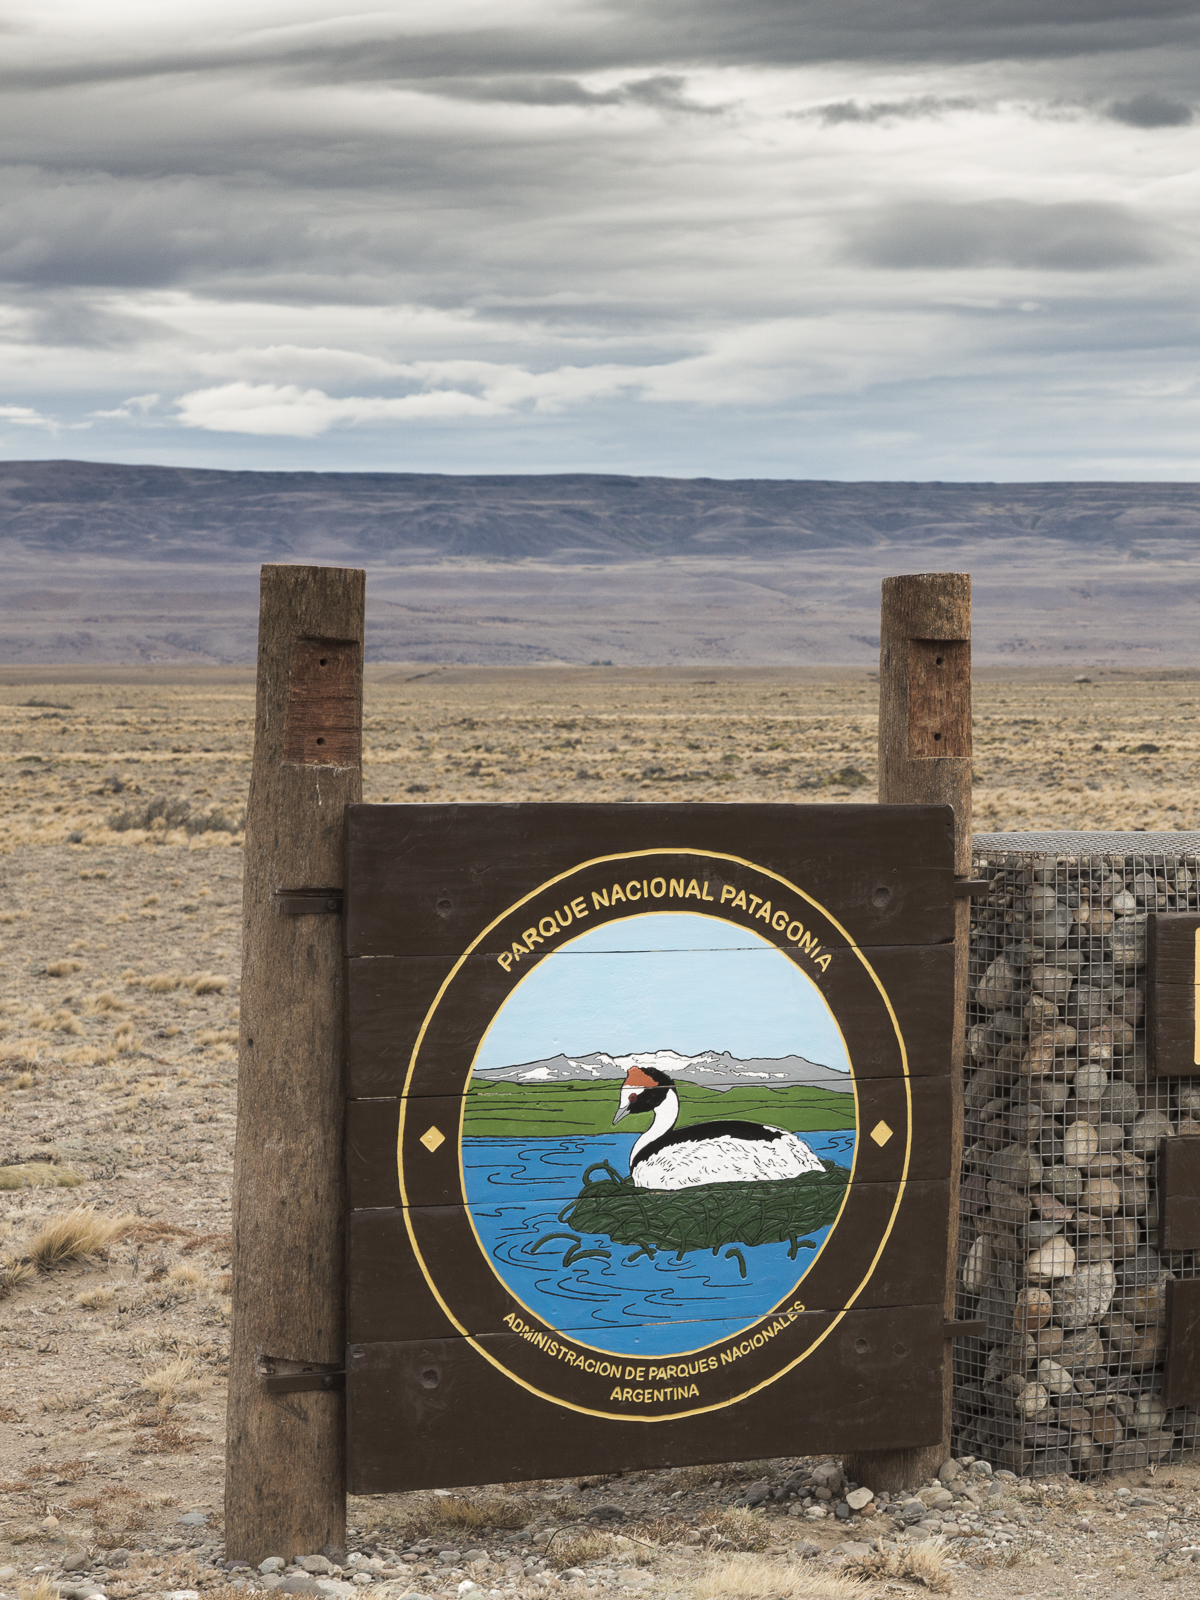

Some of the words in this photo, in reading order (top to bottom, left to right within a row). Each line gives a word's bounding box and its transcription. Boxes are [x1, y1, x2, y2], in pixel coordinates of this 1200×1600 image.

[497, 896, 589, 973] PARQUE
[591, 877, 714, 910] NACIONAL
[720, 885, 834, 973] PATAGONIA
[503, 1312, 622, 1379] ADMINISTRACION
[624, 1366, 646, 1381] DE
[648, 1357, 719, 1381] PARQUES
[721, 1301, 806, 1365] NACIONALES
[610, 1383, 700, 1403] ARGENTINA
